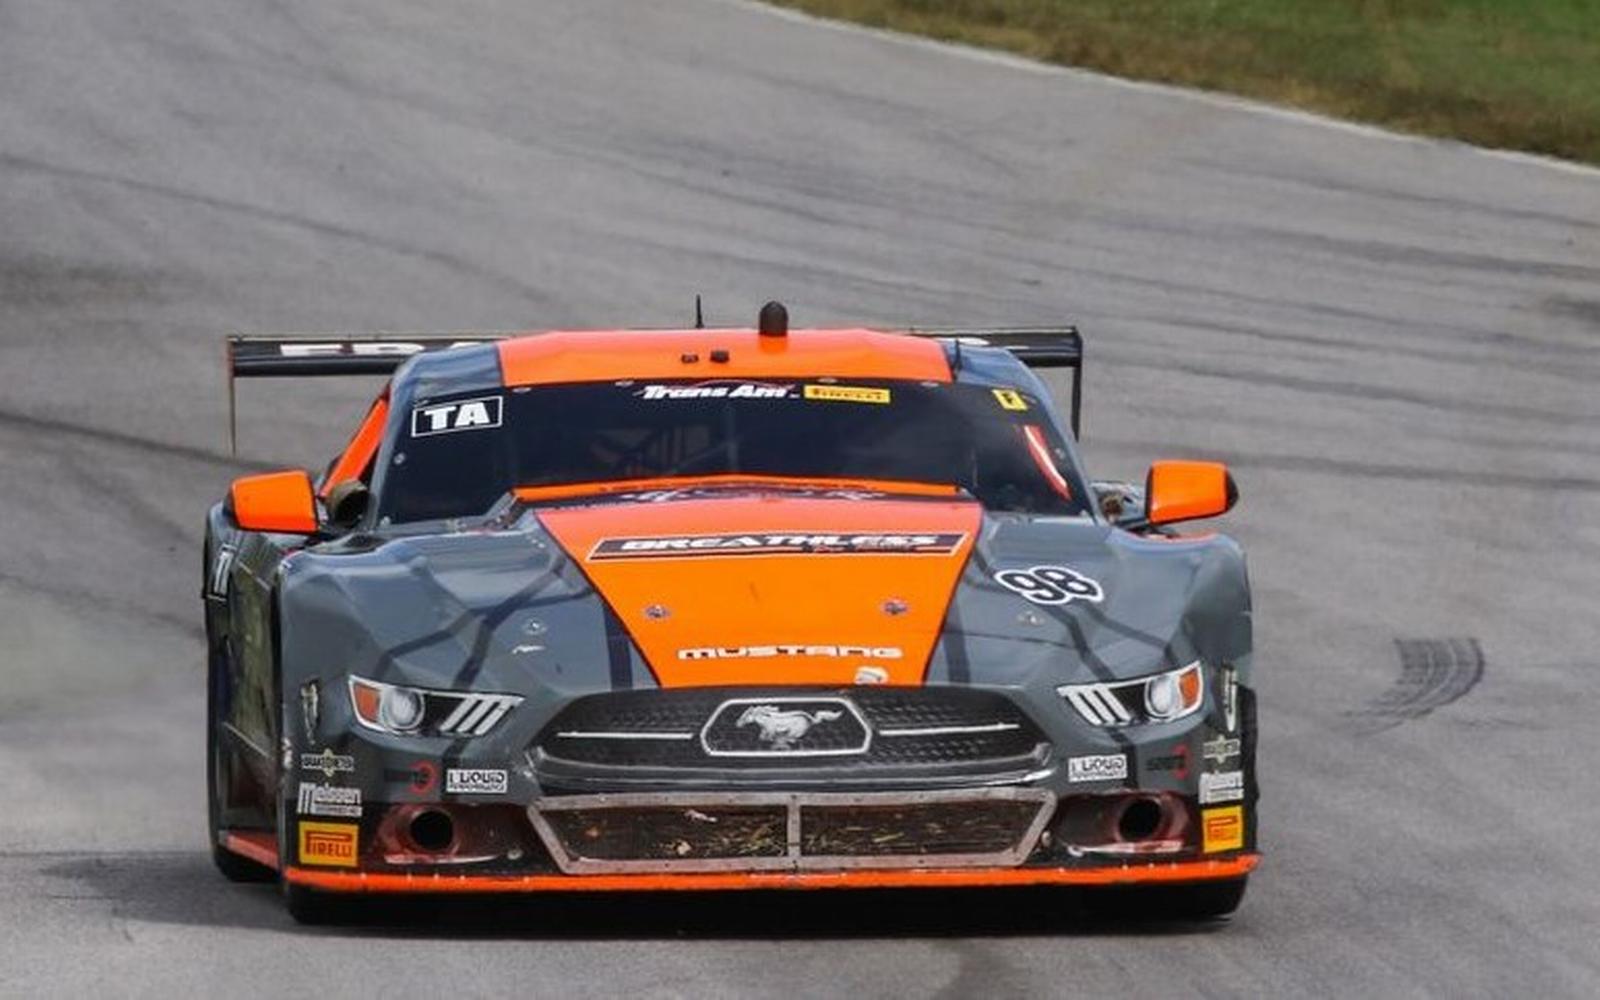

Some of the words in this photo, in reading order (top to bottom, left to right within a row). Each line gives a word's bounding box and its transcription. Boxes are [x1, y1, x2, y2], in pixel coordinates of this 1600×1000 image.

[641, 385, 728, 400] Trans
[729, 384, 788, 399] Am
[422, 401, 490, 430] TA
[620, 535, 939, 552] BREATHLESS
[997, 566, 1103, 604] 98
[677, 644, 904, 660] MUSTANG
[304, 829, 353, 858] PIRELLI
